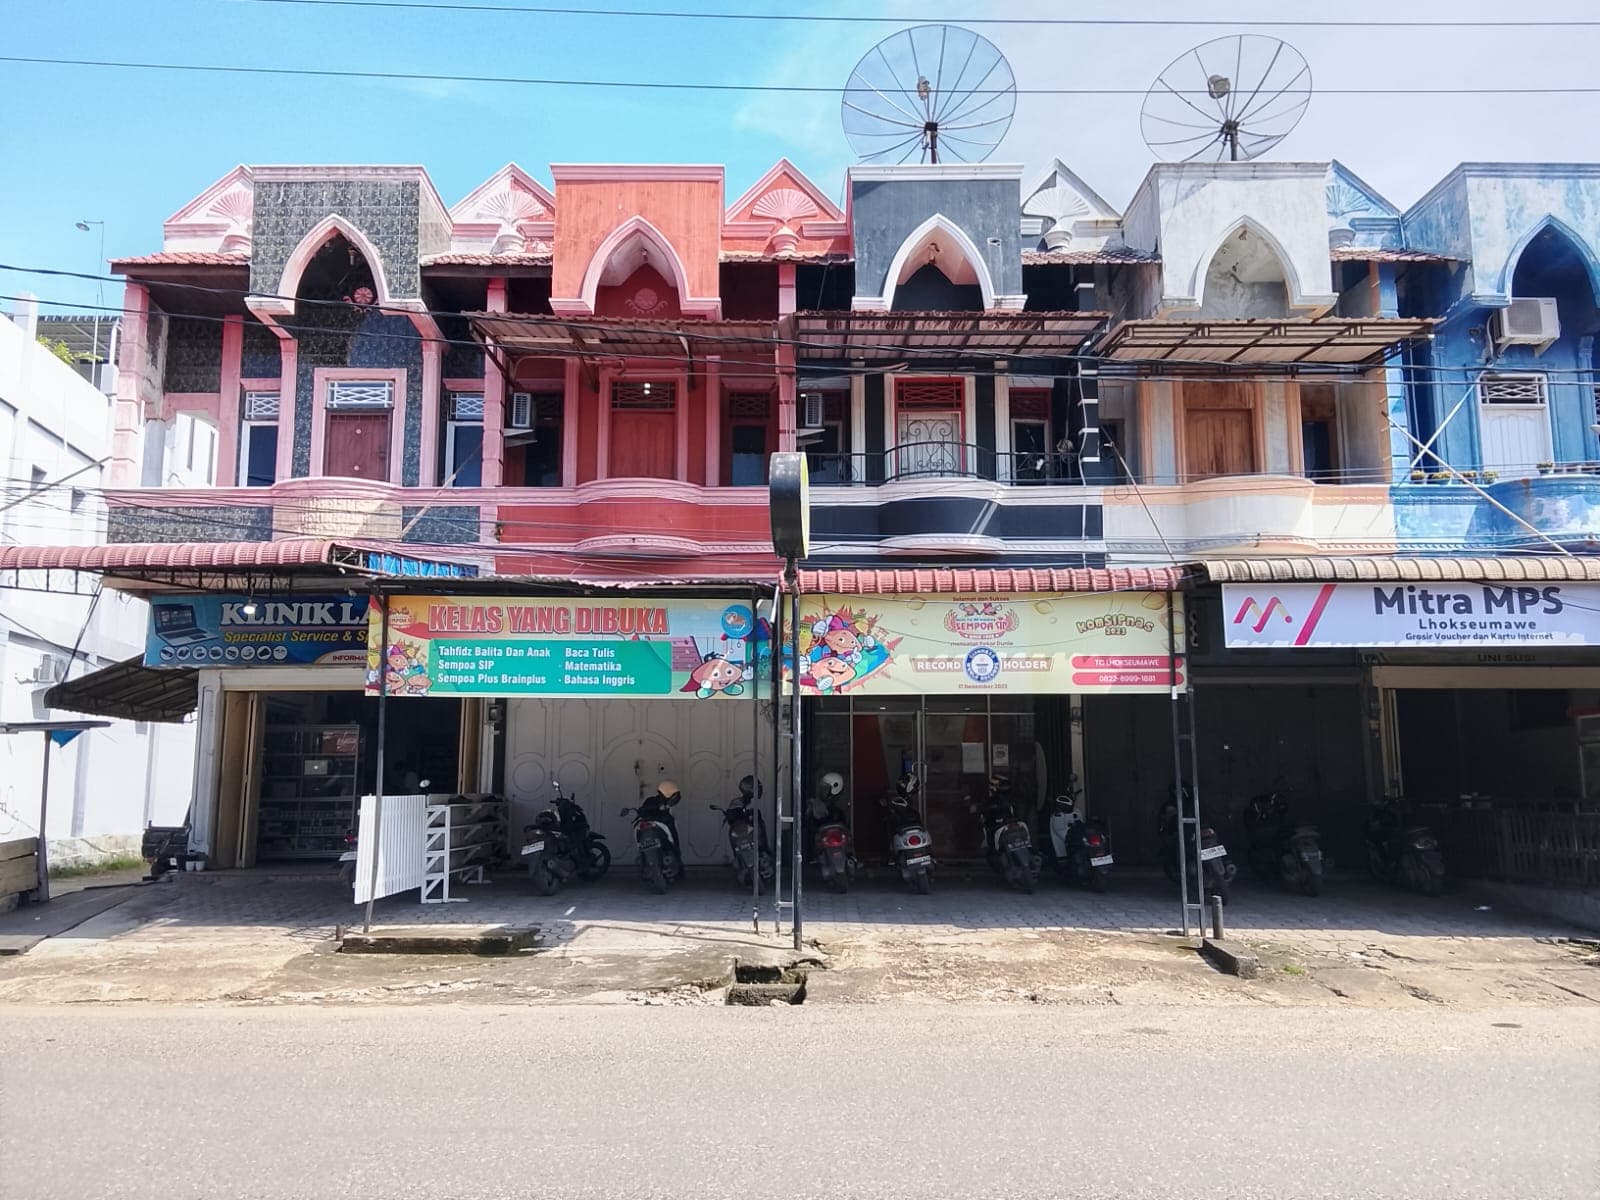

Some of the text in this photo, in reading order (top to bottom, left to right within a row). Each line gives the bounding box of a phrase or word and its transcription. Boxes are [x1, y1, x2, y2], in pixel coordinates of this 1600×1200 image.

[1373, 585, 1563, 615] Mitra MPS
[221, 602, 336, 625] KLINIK
[428, 605, 669, 635] KELAS YANG DIBUKA
[1419, 618, 1537, 630] Lhokseumawe
[224, 631, 288, 643] Specialist
[291, 631, 339, 642] Service
[343, 631, 353, 642] &
[1434, 632, 1471, 640] Voucher
[1473, 632, 1489, 640] dan
[1490, 632, 1516, 640] Kartu
[1518, 632, 1554, 640] Internet
[438, 646, 550, 657] Tahfidz Balita Dan Anak
[565, 647, 615, 658] Baca Tulis
[438, 660, 495, 672] Sempoa SIP
[564, 661, 622, 672] Matematika
[917, 660, 1048, 670] RECORD HOLDER
[438, 673, 547, 686] Sempoa Plus Brainplus
[564, 674, 636, 687] Bahasa Inggris
